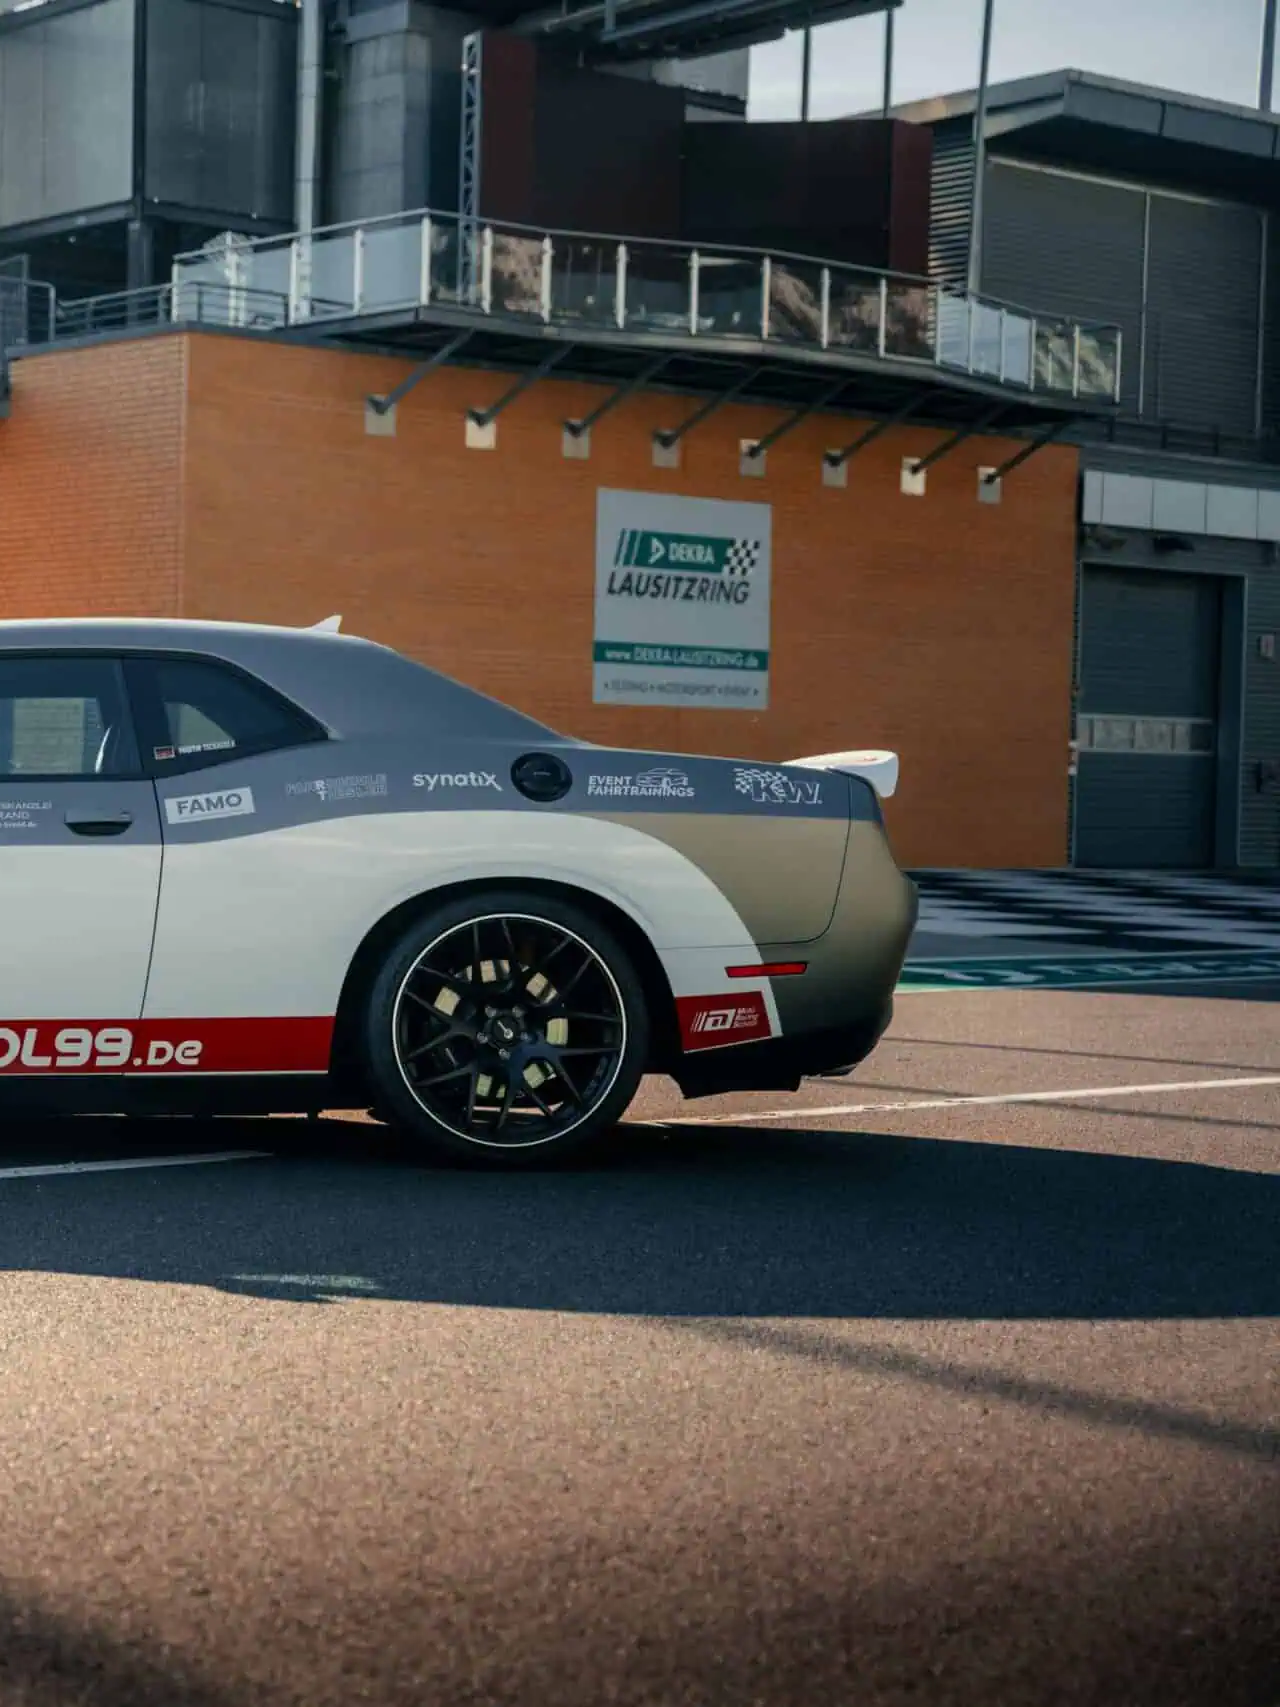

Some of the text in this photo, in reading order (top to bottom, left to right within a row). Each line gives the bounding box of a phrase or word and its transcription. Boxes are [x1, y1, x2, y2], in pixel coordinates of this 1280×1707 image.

[668, 542, 715, 565] DEKRA
[607, 571, 750, 605] LAUSITZRING
[413, 772, 503, 791] synatix
[588, 775, 633, 786] EVENT
[587, 785, 696, 798] FAHRTRAININGS
[176, 793, 242, 815] FAMO
